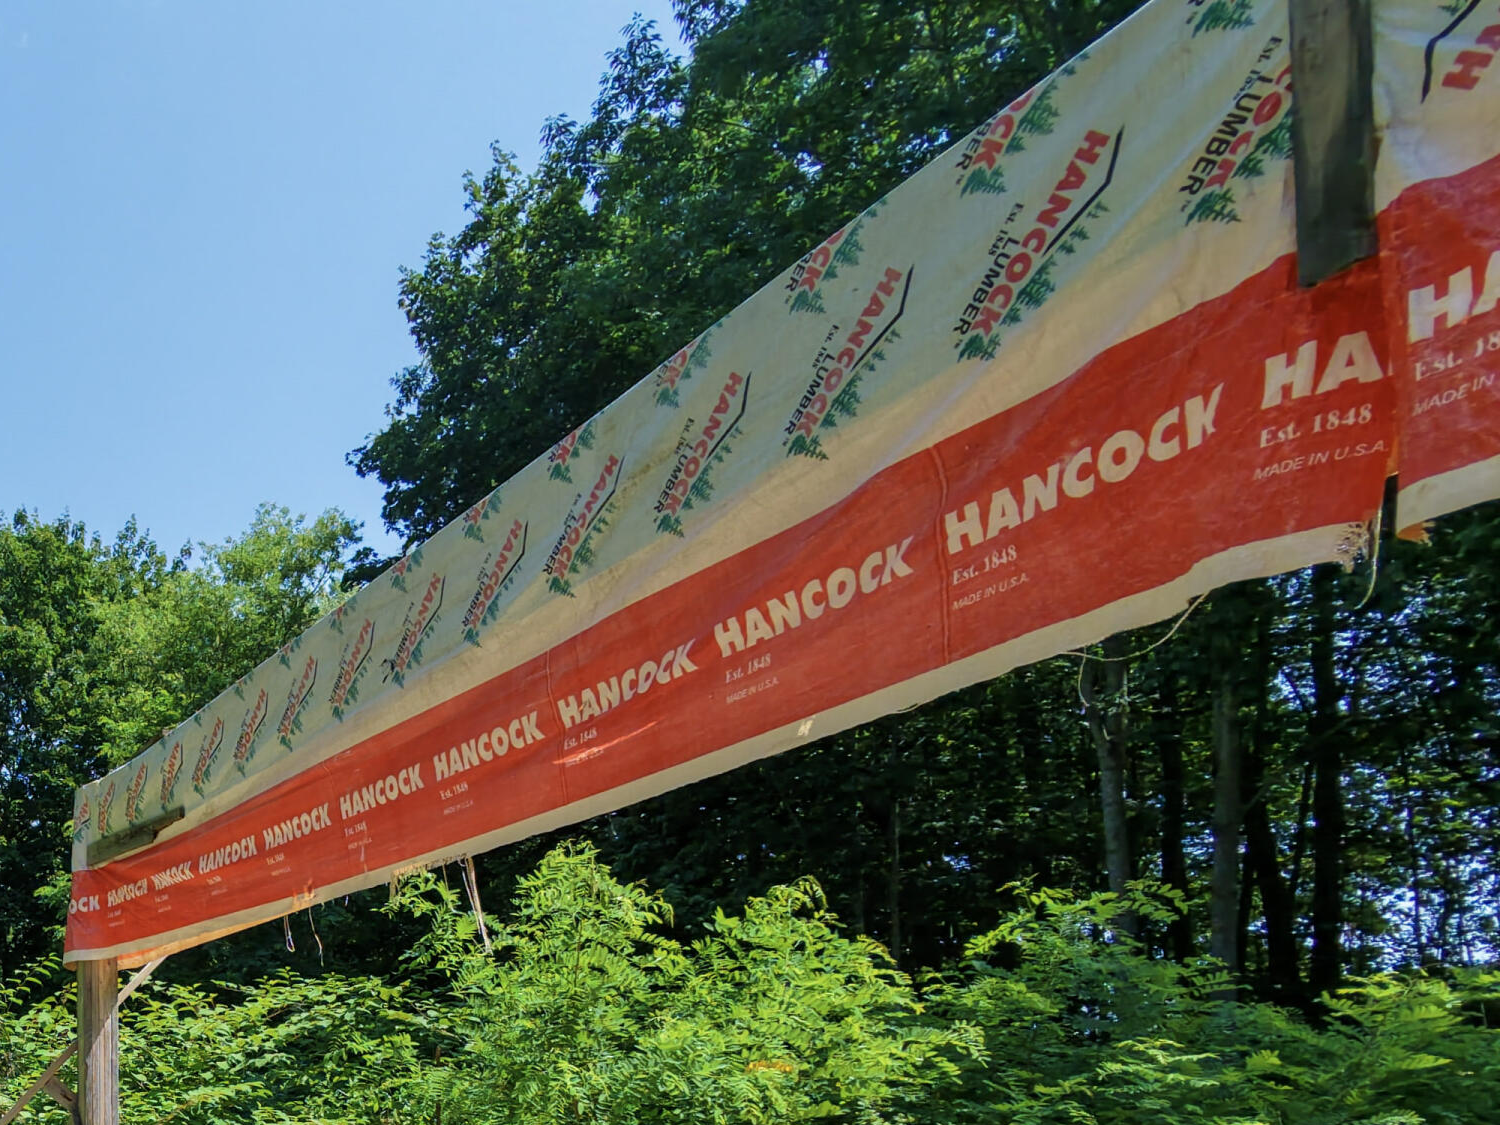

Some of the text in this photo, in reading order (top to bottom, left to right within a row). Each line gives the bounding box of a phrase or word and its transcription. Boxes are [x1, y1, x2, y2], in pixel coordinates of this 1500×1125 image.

[970, 130, 1111, 337] HANCOCK
[953, 237, 1021, 335] LUMBER
[795, 266, 903, 438] HANCOCK
[1414, 350, 1463, 381] Est.
[783, 353, 835, 435] LUMBER
[1259, 403, 1373, 448] Est. 1848
[1412, 374, 1495, 417] MADE IN
[654, 441, 694, 513] LUMBER
[664, 371, 744, 517] HANCOCK
[1253, 456, 1306, 481] MADE
[1308, 451, 1330, 466] IN
[542, 515, 577, 575] LUMBER
[553, 454, 619, 580] HANCOCK
[469, 519, 523, 629] HANCOCK
[952, 544, 1017, 586] Est. 1848
[952, 590, 982, 611] MADE
[983, 584, 997, 598] IN
[198, 835, 258, 874] HANCOCK
[262, 803, 332, 851] HANCOCK
[339, 763, 424, 820] HANCOCK
[432, 711, 546, 783] HANCOCK
[556, 638, 699, 729] HANCOCK
[713, 535, 915, 658] HANCOCK
[944, 382, 1225, 555] HANCOCK
[725, 652, 771, 684] Est. 1848
[580, 727, 598, 744] 1848
